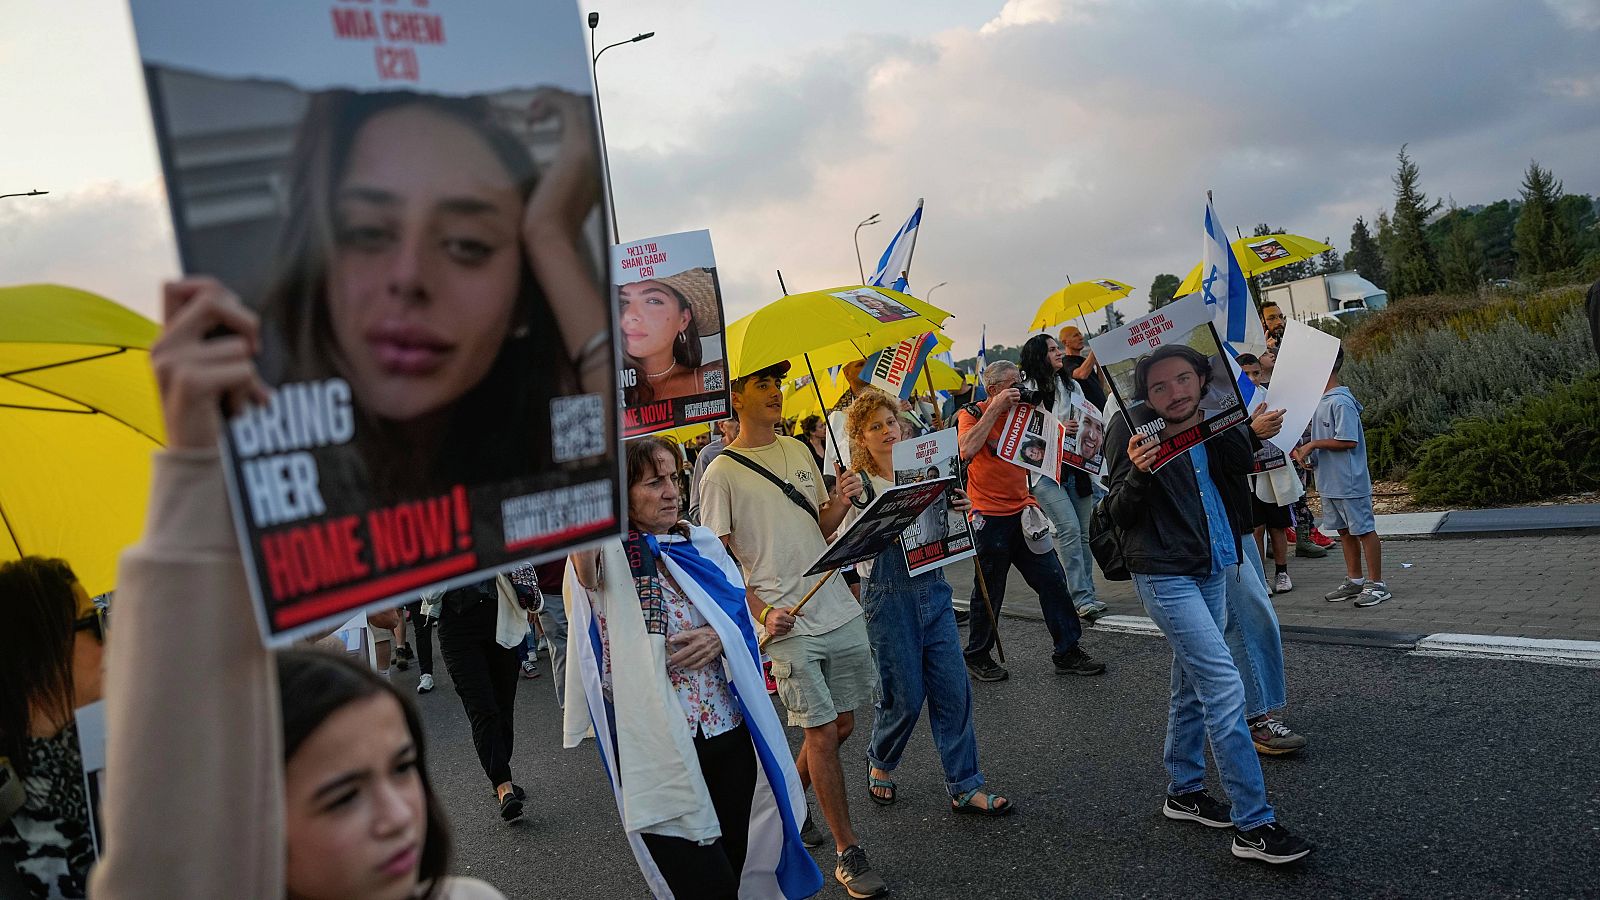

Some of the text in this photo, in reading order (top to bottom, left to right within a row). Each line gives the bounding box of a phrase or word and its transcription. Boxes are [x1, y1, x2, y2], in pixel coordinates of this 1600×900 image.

[332, 8, 446, 44] MIA CHEM
[646, 243, 657, 254] שני
[621, 252, 667, 270] SHANI GABAY
[639, 266, 654, 278] (26)
[1127, 319, 1174, 347] OMER SHEM TOV
[1148, 336, 1161, 348] (21)
[640, 400, 673, 426] NOW!
[1003, 405, 1027, 457] KIDNAPPED
[1173, 426, 1201, 449] NOW!
[242, 451, 326, 528] HER
[261, 515, 370, 601] HOME
[367, 484, 473, 571] NOW!
[908, 547, 925, 564] HOME
[925, 541, 944, 558] NOW!
